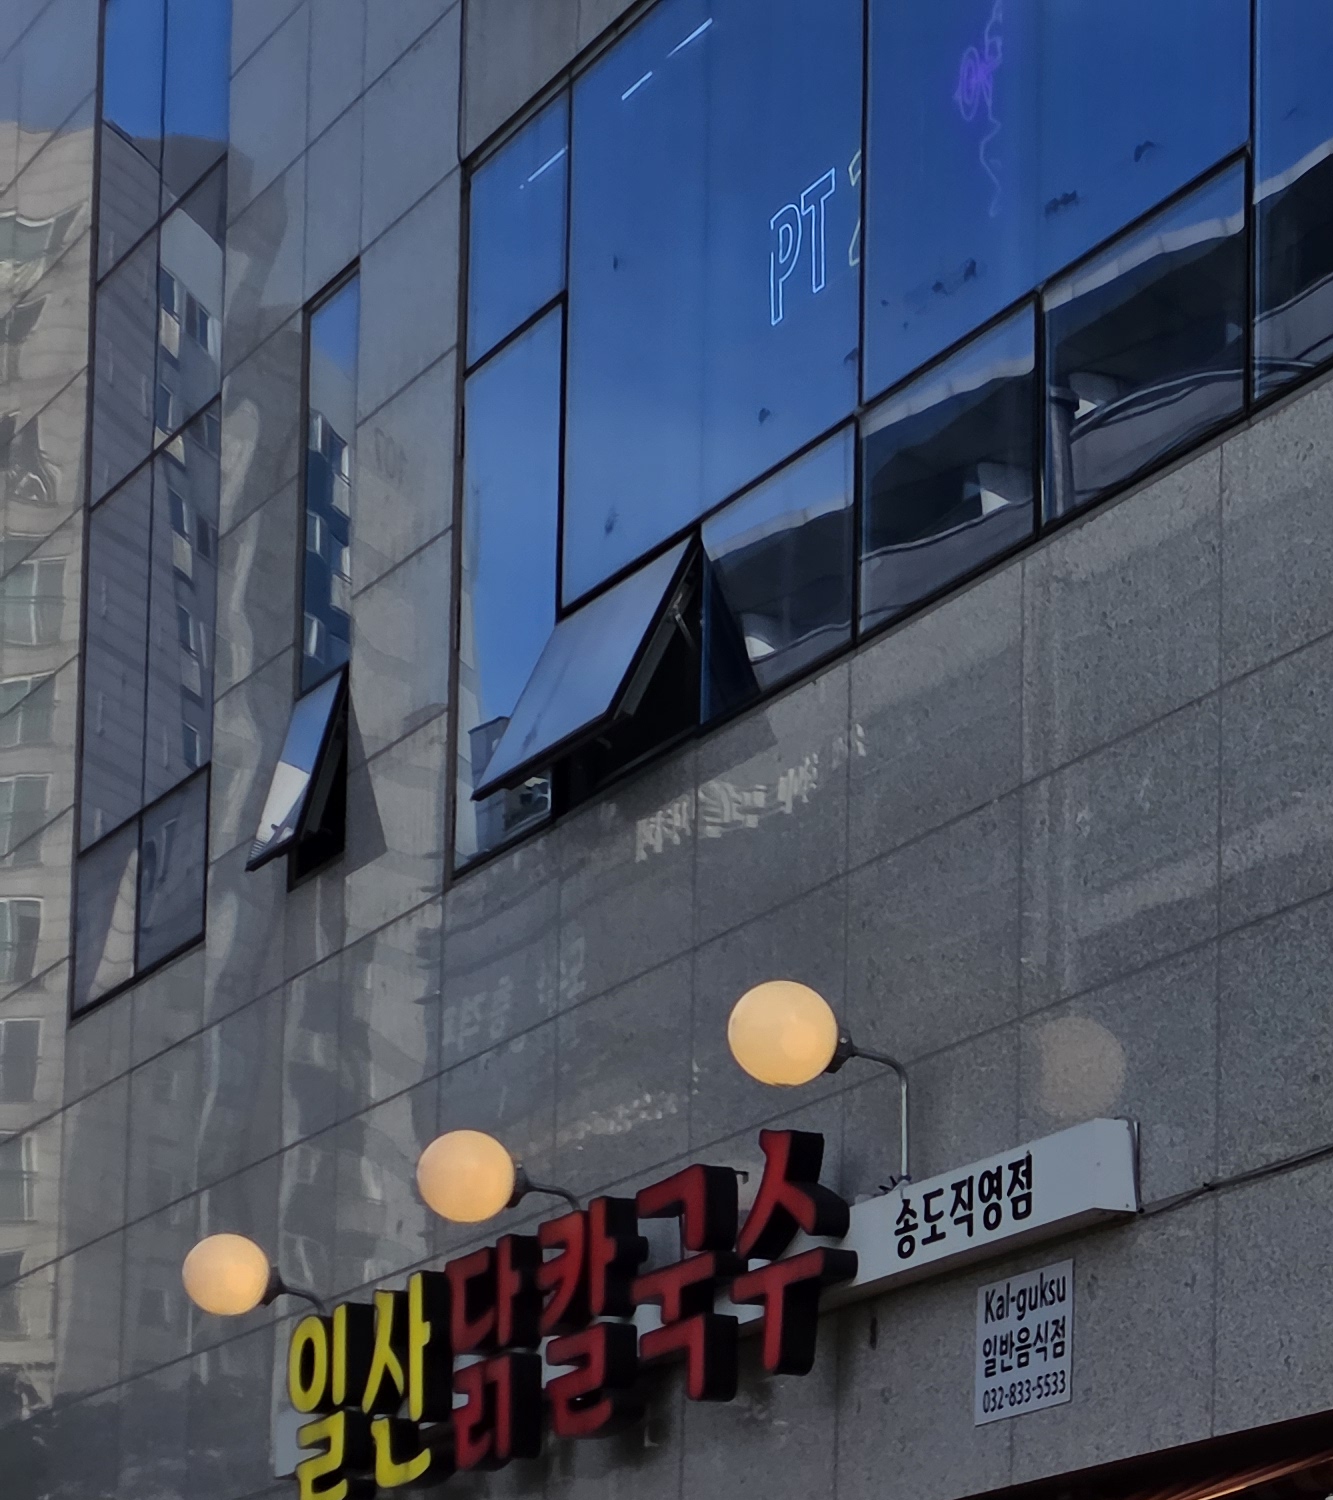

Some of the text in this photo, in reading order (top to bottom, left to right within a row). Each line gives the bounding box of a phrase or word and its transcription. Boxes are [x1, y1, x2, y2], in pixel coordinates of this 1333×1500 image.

[769, 166, 836, 326] PT
[894, 1153, 1033, 1259] 송도직영점
[984, 1271, 1066, 1325] Kal-guksu
[983, 1315, 1066, 1378] 일반음식점
[983, 1369, 1066, 1414] 032-833-5533
